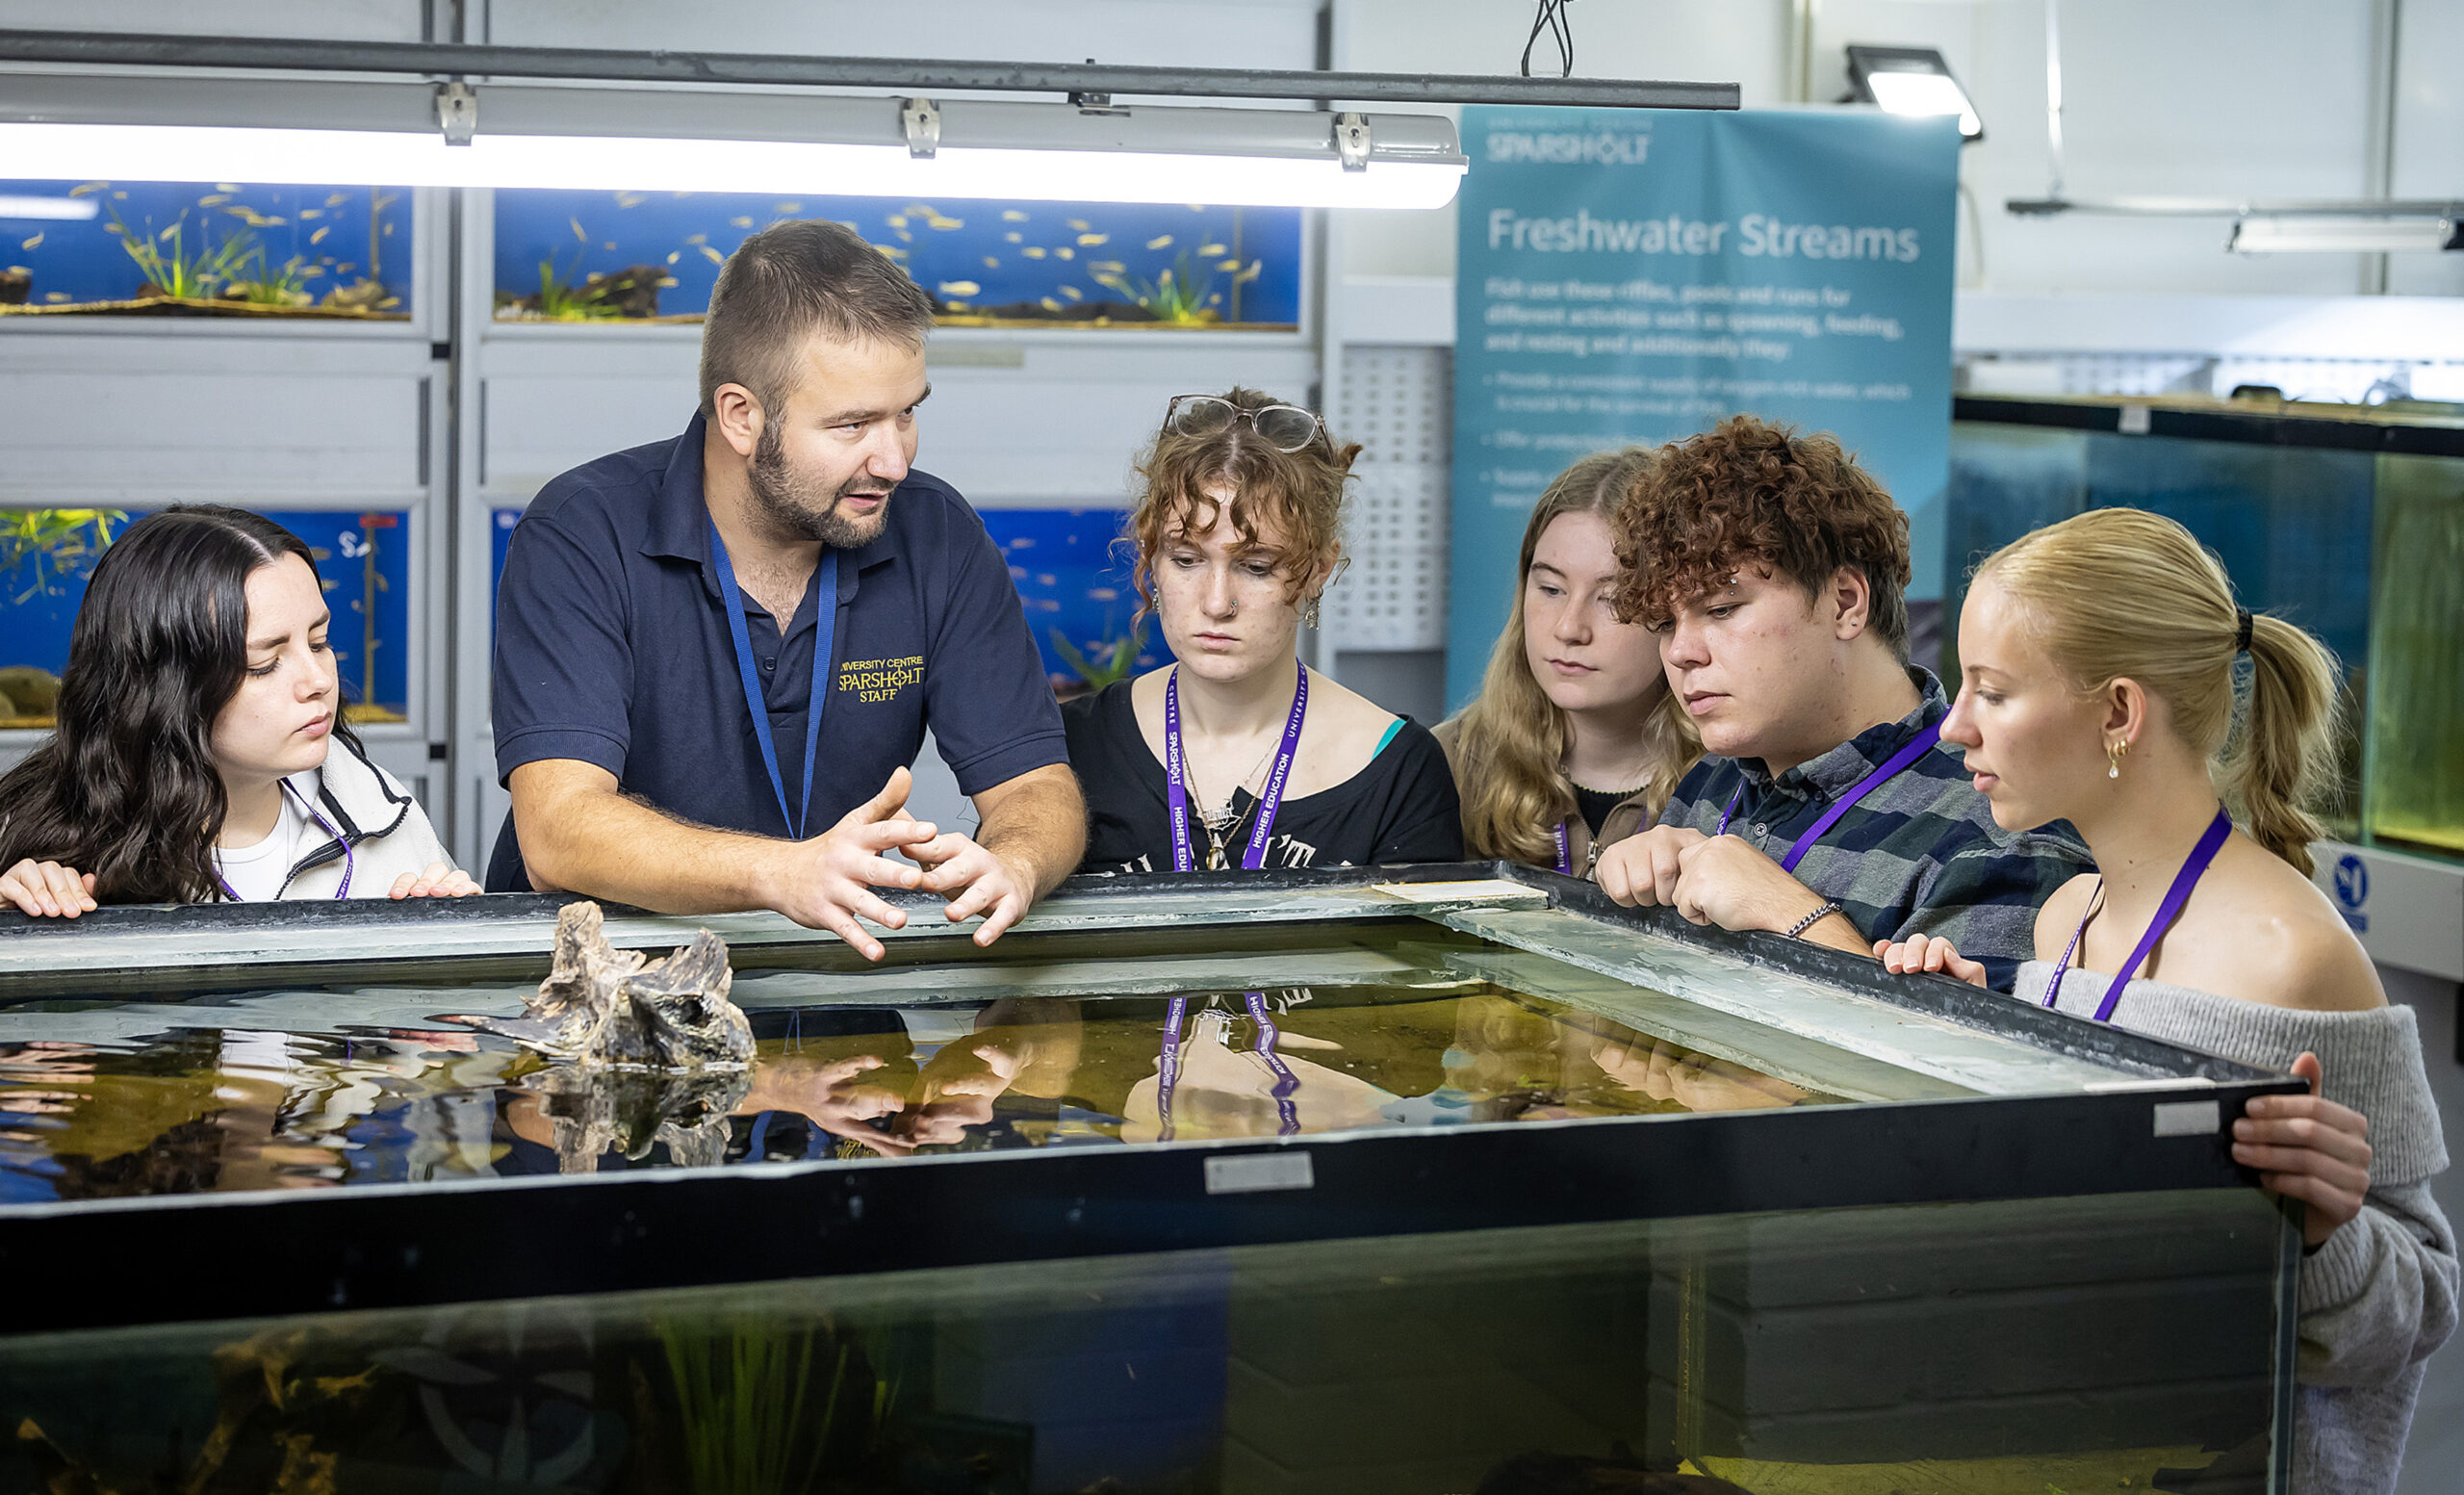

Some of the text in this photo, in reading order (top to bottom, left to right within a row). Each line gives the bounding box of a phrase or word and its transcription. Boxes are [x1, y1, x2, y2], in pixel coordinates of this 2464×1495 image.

[1487, 132, 1653, 165] SPARSHOLT
[1488, 208, 1920, 263] Freshwater Streams
[1485, 276, 1523, 298] Fish
[1528, 282, 1558, 299] use
[1565, 278, 1612, 300] these
[1737, 284, 1773, 305] and
[1822, 283, 1850, 307] for
[1484, 303, 1565, 325] different
[1571, 307, 1650, 327] activities
[1655, 309, 1698, 329] such
[1705, 313, 1723, 330] as
[1485, 331, 1522, 352] and
[1593, 334, 1628, 353] and
[839, 666, 924, 691] SPARSHOLT
[886, 656, 923, 668] CENTRE
[860, 688, 897, 703] STAFF
[1288, 680, 1306, 738] UNIVERSITY
[1168, 732, 1182, 786] SPARSHOLT
[1252, 753, 1290, 849] HIGHER EDUCATION
[1173, 806, 1187, 870] HIGHER EDU
[1553, 831, 1565, 867] HIGHER
